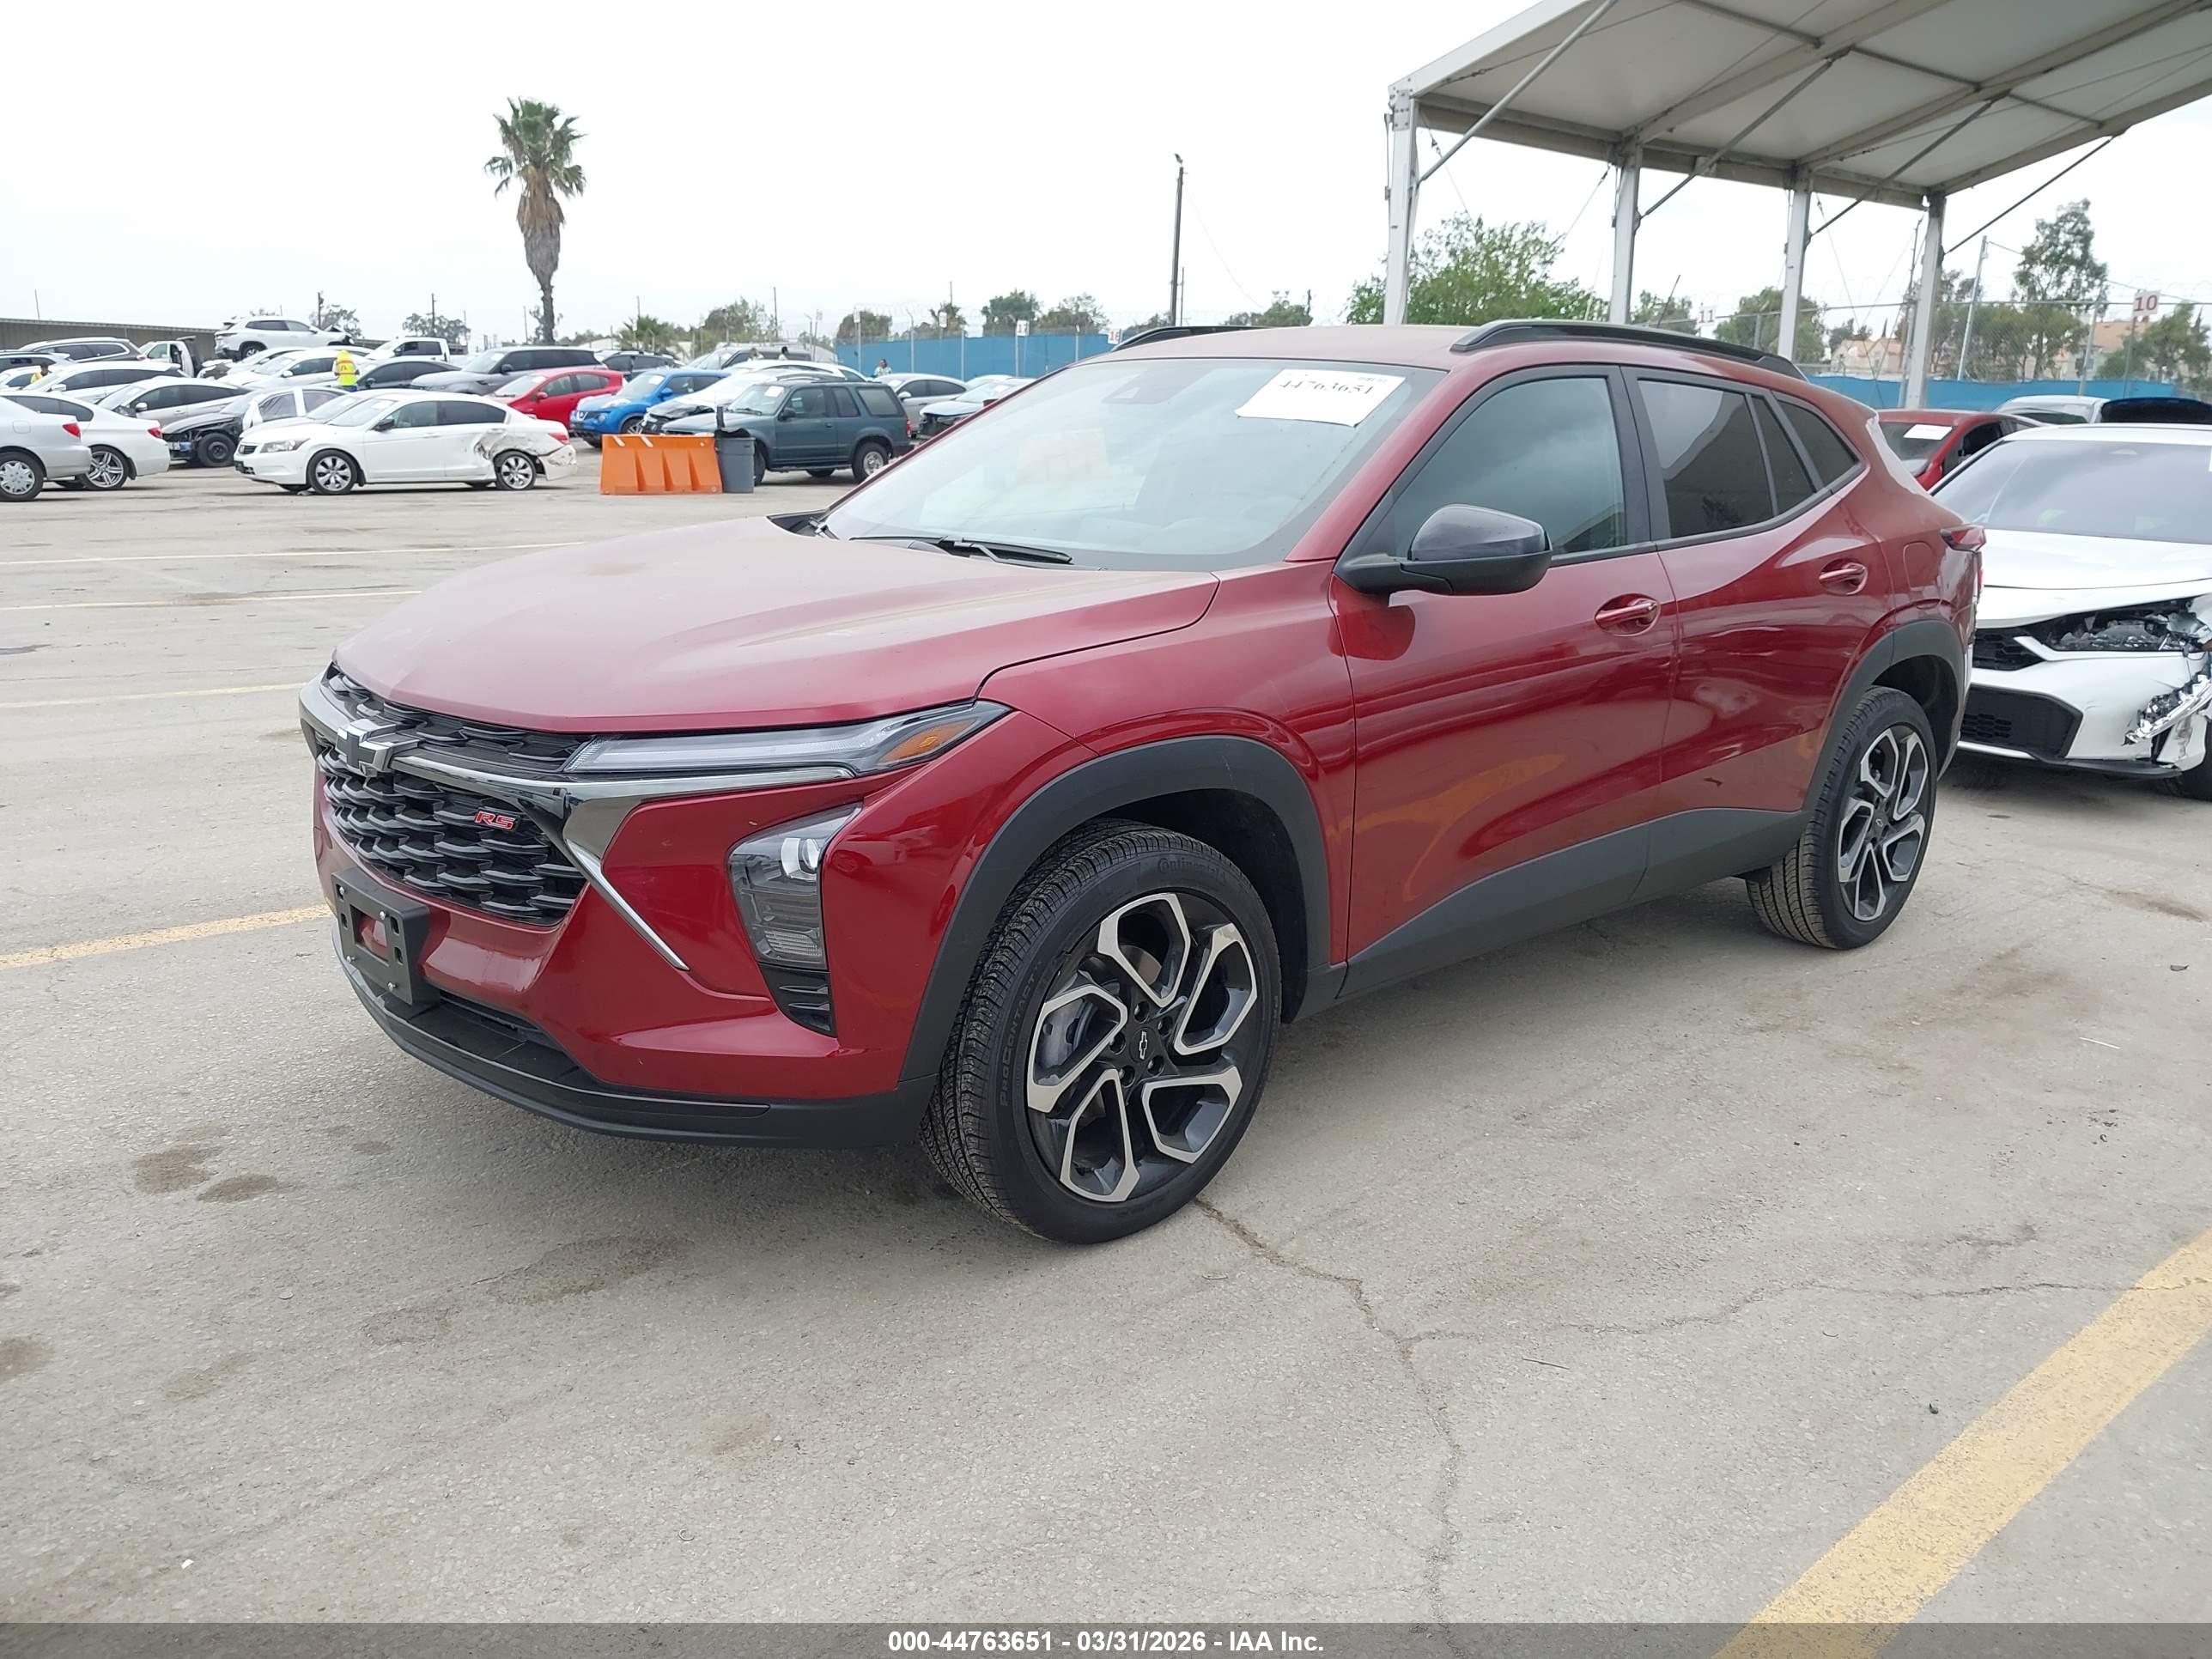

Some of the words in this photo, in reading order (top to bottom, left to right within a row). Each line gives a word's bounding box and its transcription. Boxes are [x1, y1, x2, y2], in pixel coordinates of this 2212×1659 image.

[2134, 295, 2158, 312] 10
[1698, 309, 1714, 323] 11
[474, 811, 516, 830] RS
